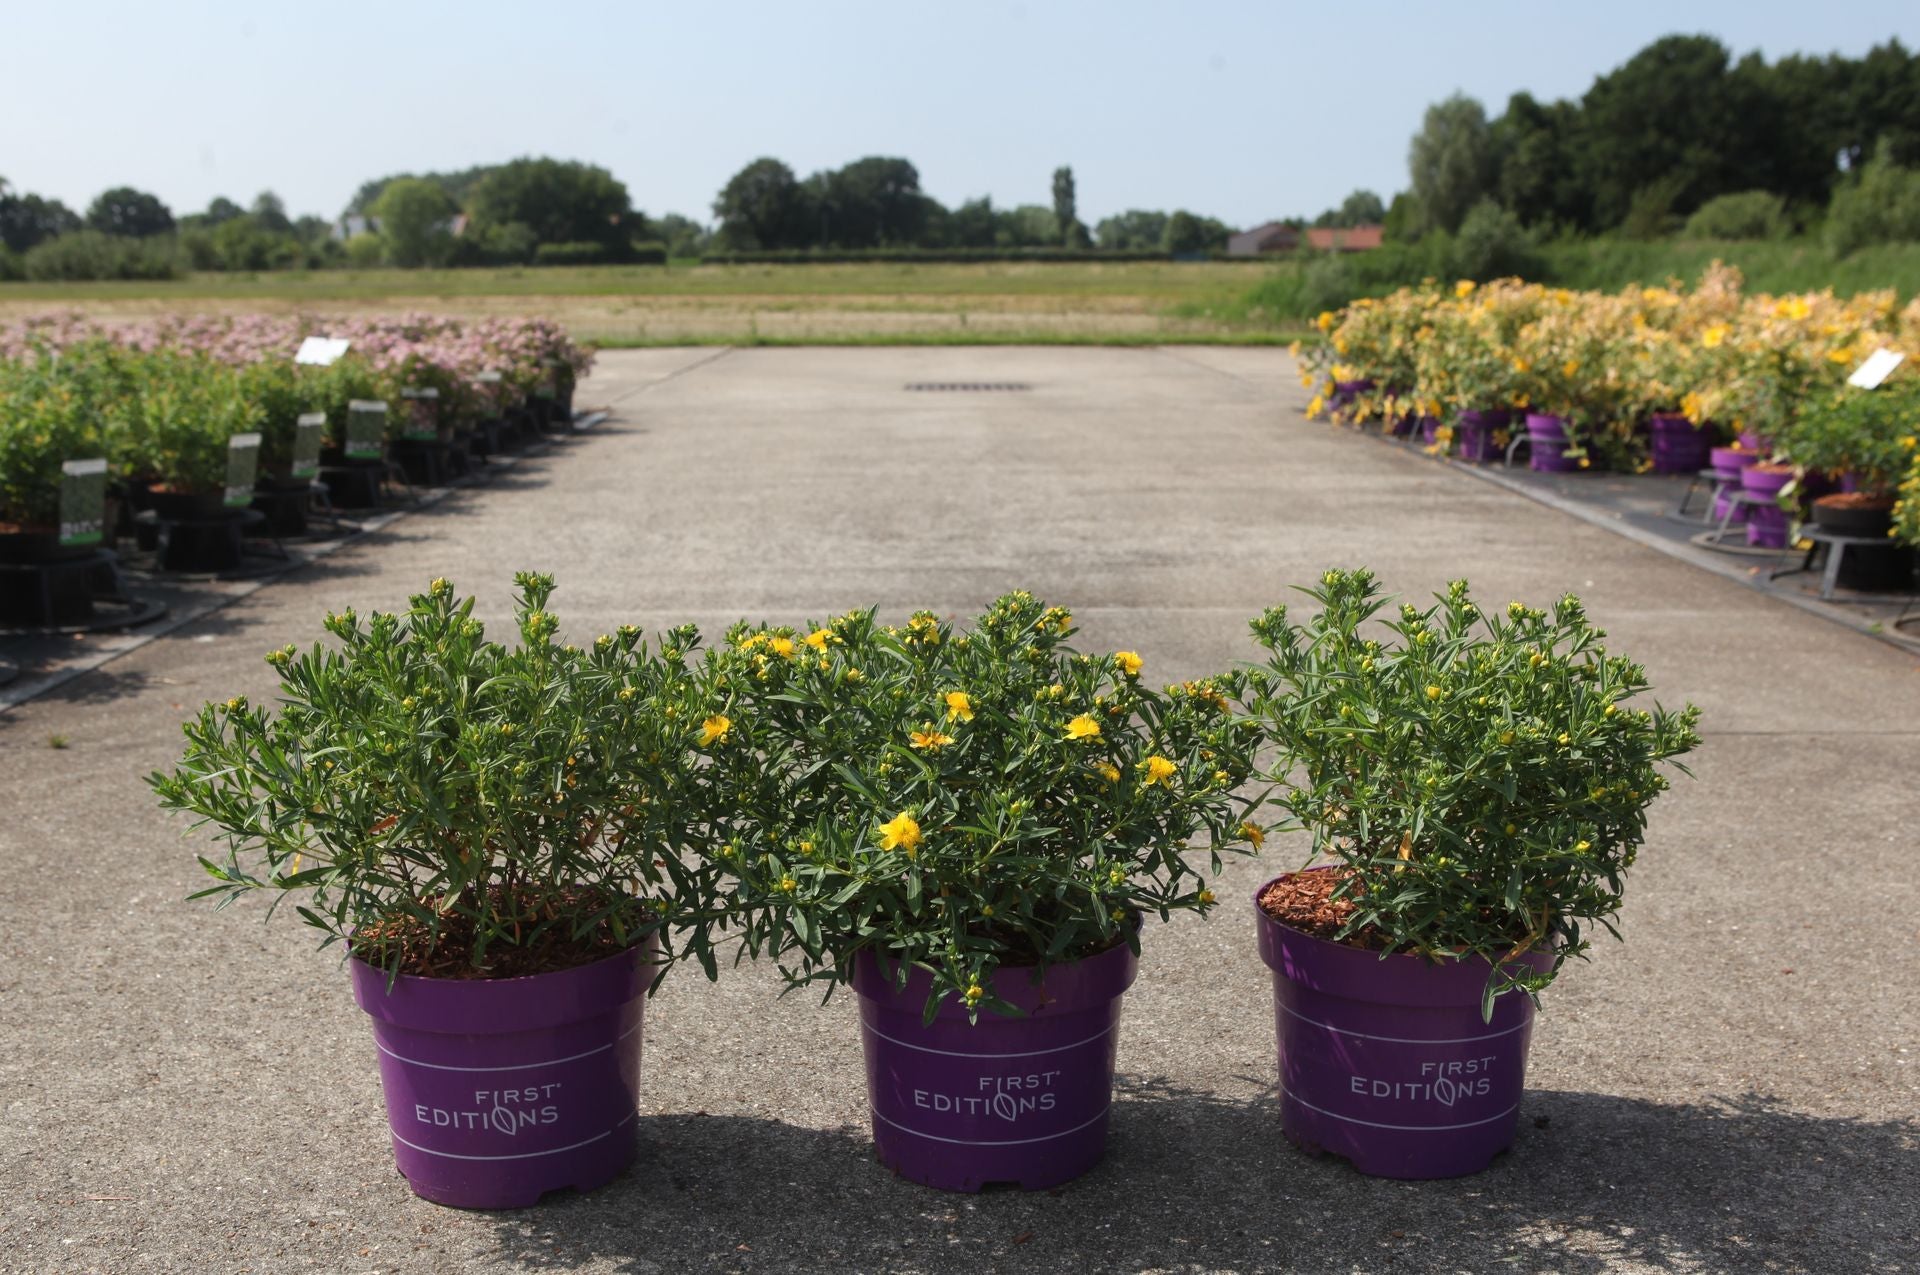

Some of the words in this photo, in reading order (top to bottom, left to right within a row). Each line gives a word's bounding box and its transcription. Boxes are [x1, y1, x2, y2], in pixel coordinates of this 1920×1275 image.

[1421, 1056, 1493, 1077] FIRST
[475, 1083, 557, 1106] FIRST
[979, 1072, 1056, 1093] FIRST
[1351, 1076, 1490, 1106] EDITIONS
[914, 1089, 1056, 1122] EDITIONS
[415, 1104, 559, 1136] EDITIONS
